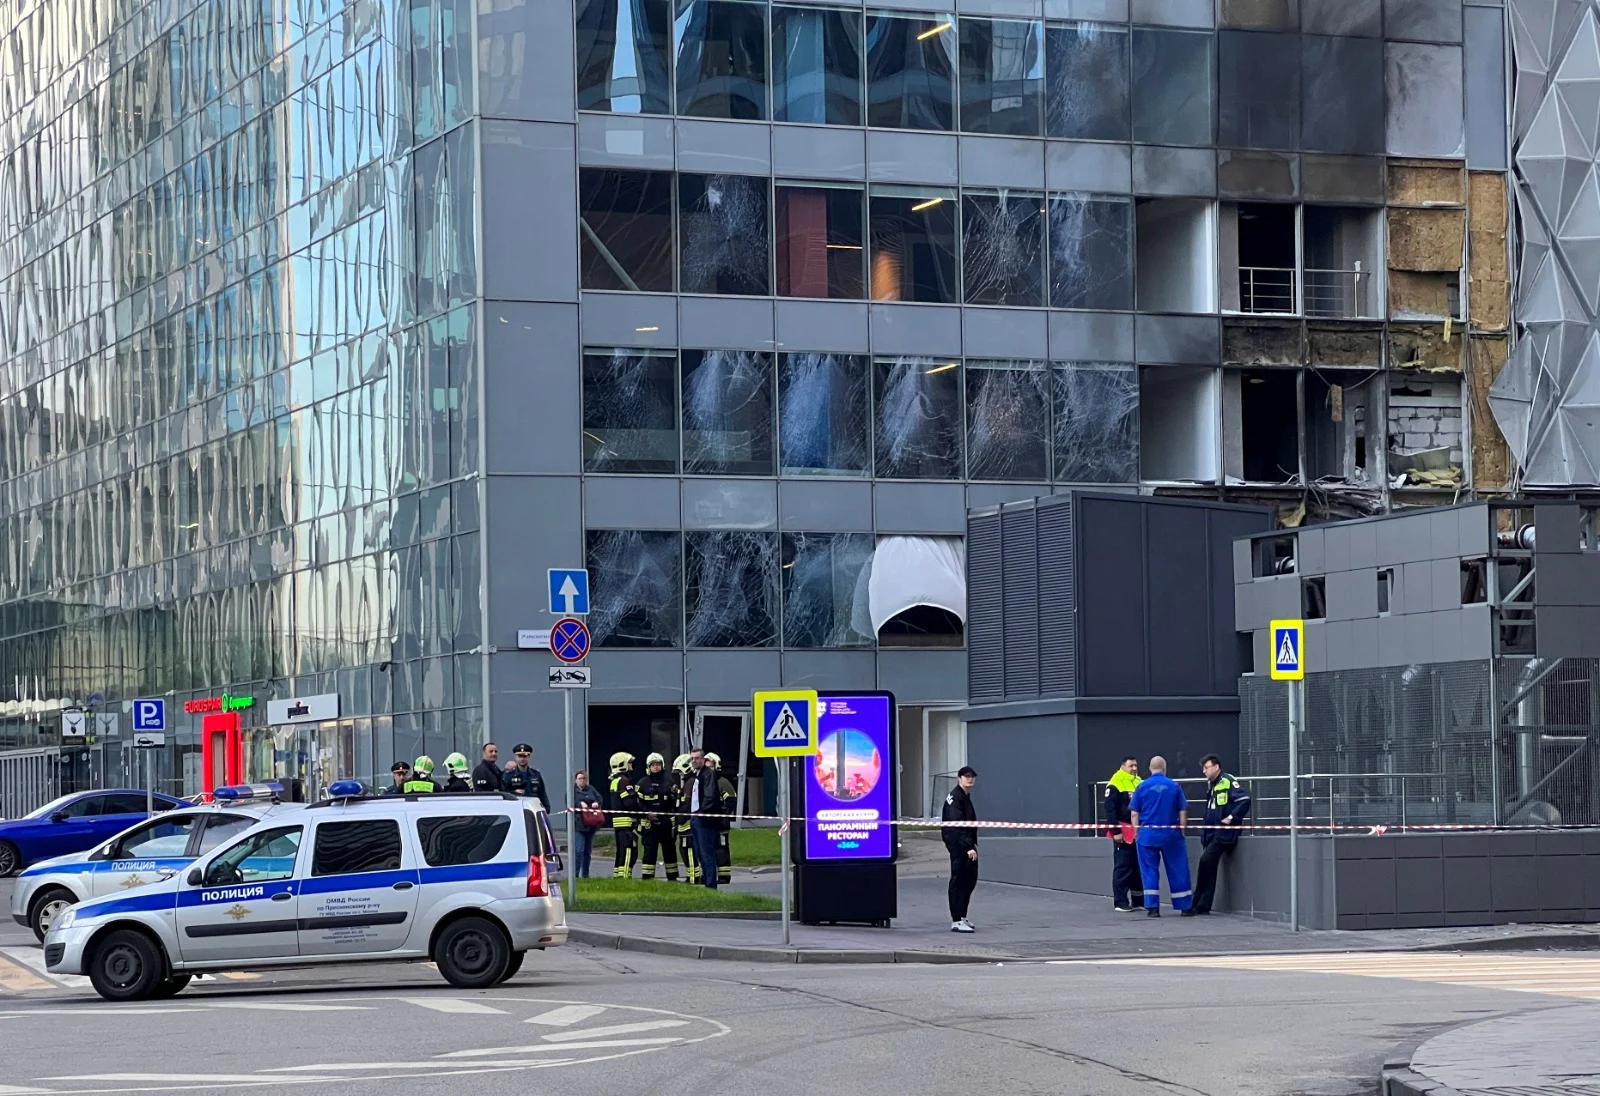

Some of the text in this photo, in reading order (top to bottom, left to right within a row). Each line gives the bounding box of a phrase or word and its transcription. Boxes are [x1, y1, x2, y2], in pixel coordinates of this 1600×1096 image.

[184, 698, 221, 713] EUROSPAR
[140, 702, 157, 726] P
[818, 822, 878, 831] ПАНОРАМНЫЙ
[827, 831, 869, 840] РЕСТОРАН
[111, 861, 156, 871] ПОЛИЦИЯ
[202, 886, 264, 901] ПОЛИЦИЯ
